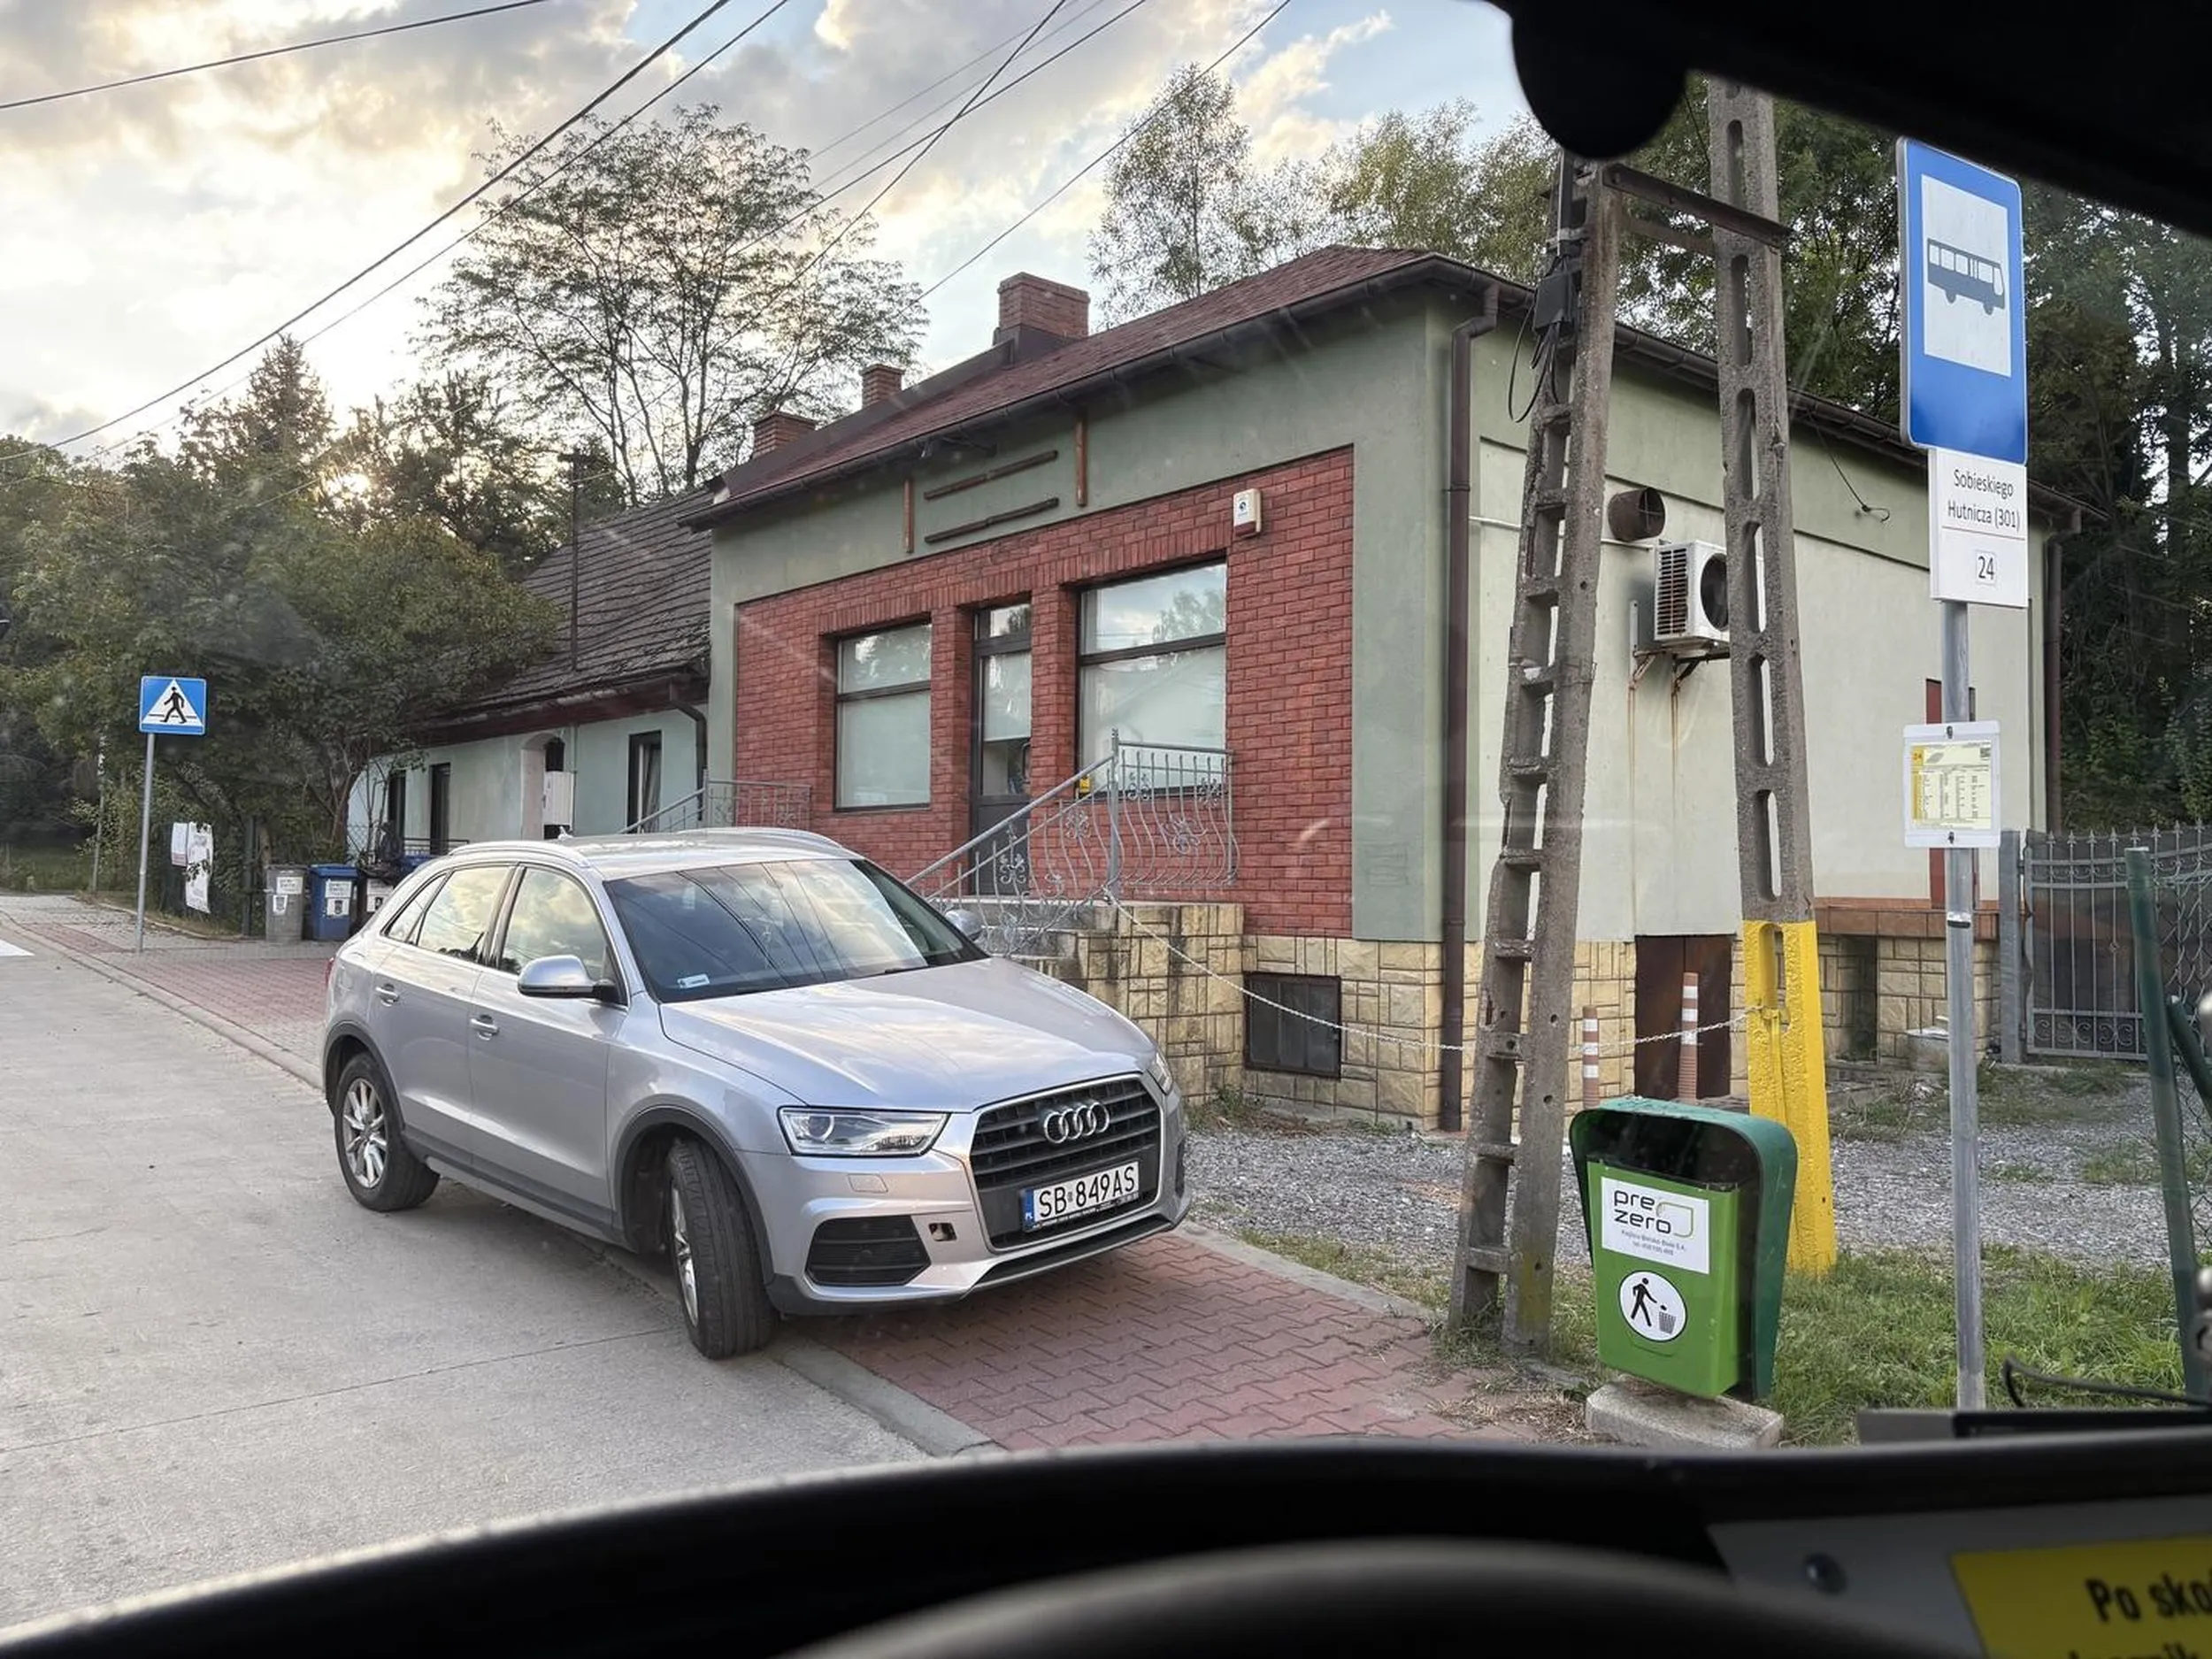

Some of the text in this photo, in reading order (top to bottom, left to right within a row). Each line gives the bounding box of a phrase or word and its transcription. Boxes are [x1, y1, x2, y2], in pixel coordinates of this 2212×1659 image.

[1954, 469, 2014, 499] Sobieskiego
[1948, 499, 2021, 532] Hutnicza (301)
[1978, 556, 1995, 580] 24
[1039, 1187, 1067, 1217] SB
[1075, 1166, 1135, 1208] 849AS
[1613, 1189, 1655, 1210] pre
[1613, 1209, 1671, 1235] zero
[2084, 1566, 2212, 1624] Po sko
